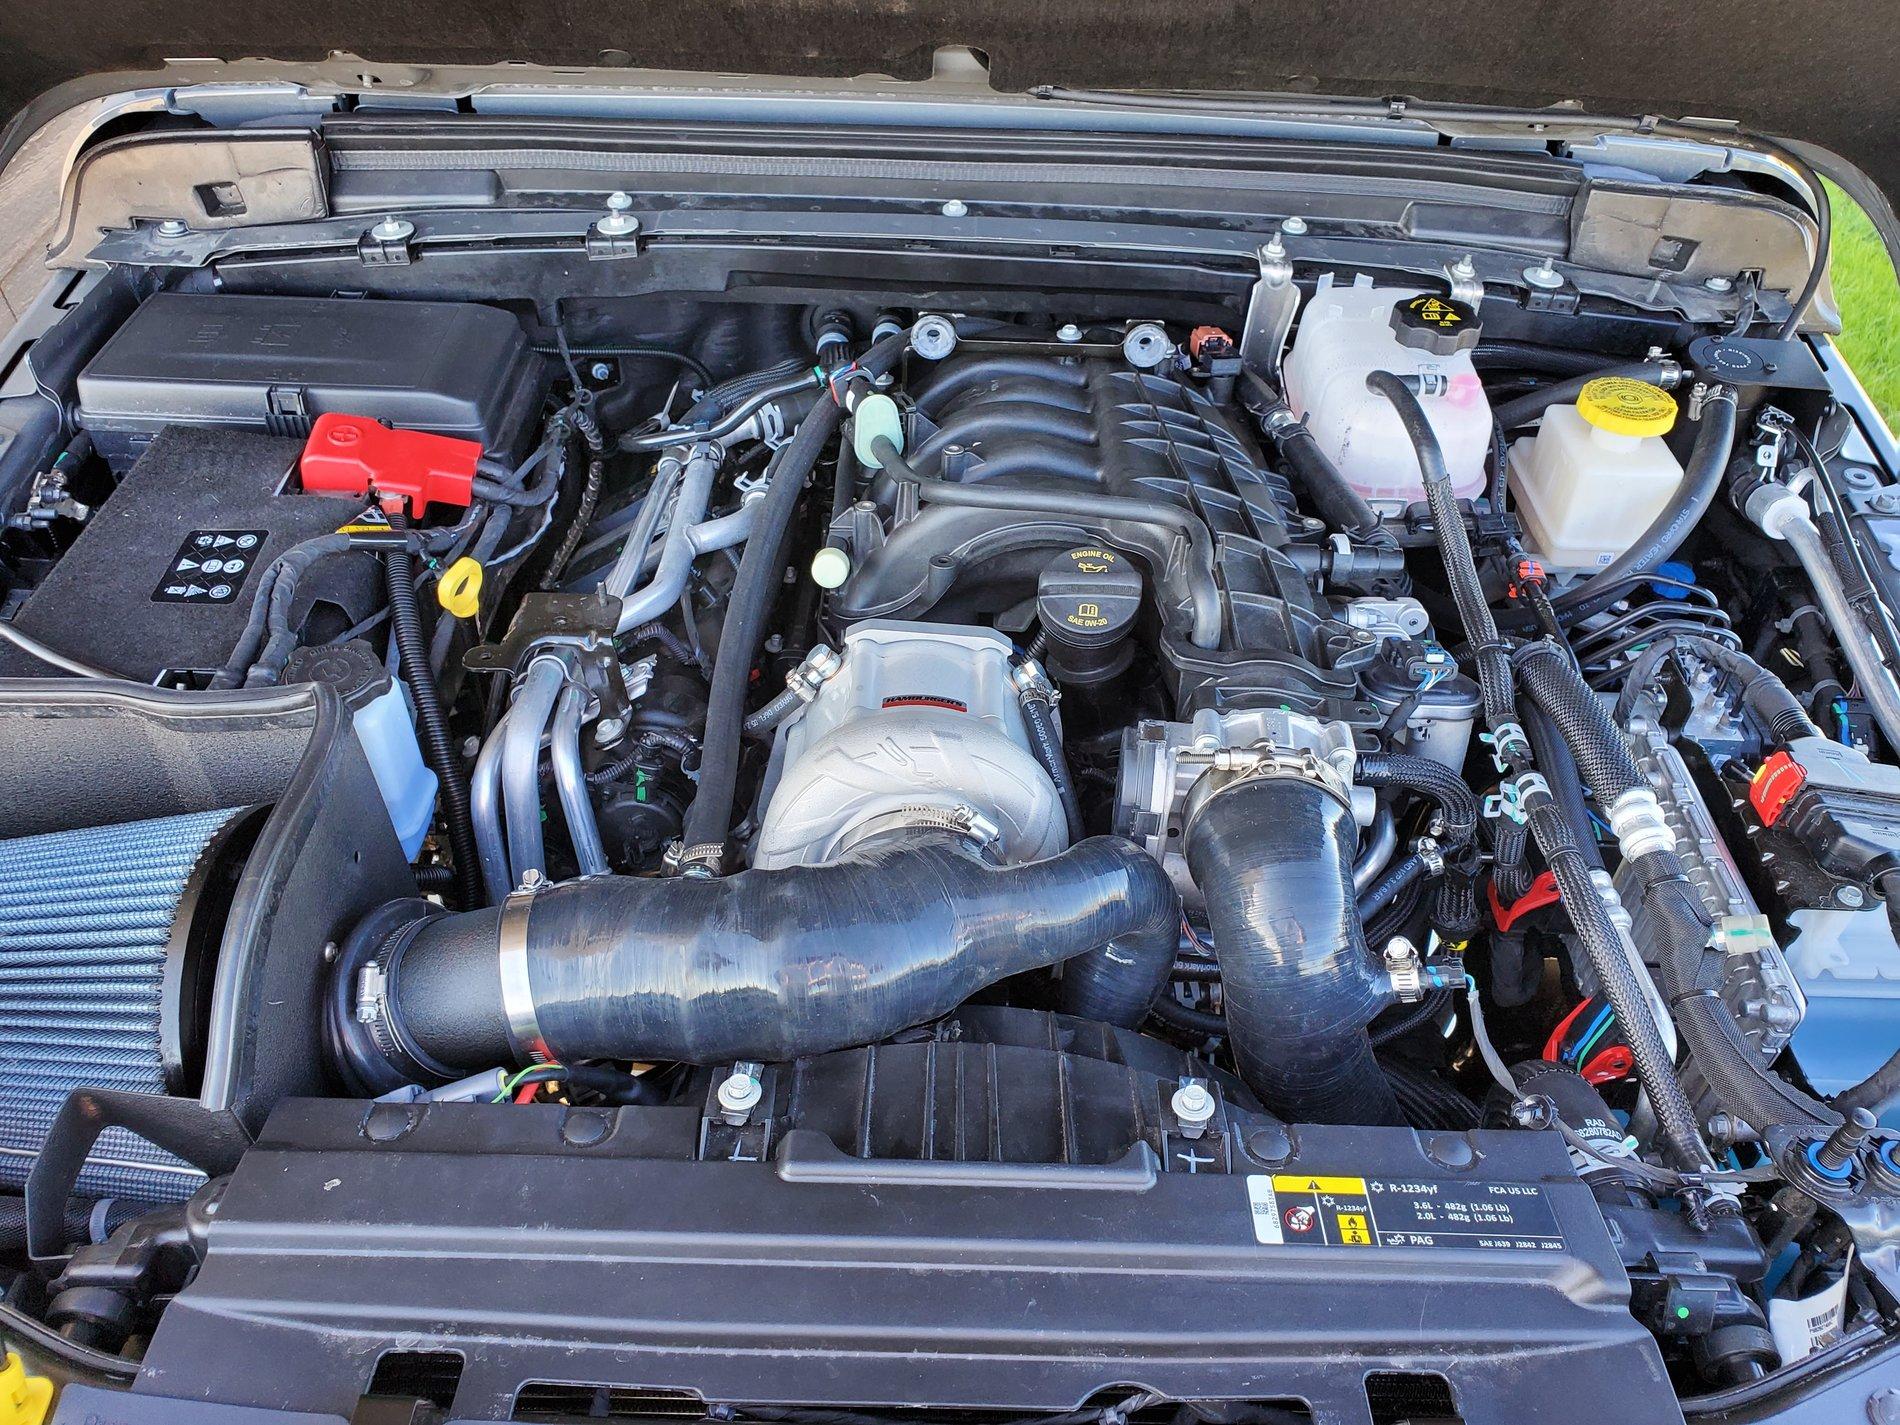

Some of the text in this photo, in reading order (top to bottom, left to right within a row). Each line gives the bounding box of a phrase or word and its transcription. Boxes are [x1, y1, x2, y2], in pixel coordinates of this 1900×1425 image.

[1635, 508, 1690, 571] STANDARD HEATER
[1071, 550, 1115, 563] ENGINE OIL
[1067, 615, 1108, 627] SAE 0W-20
[774, 692, 794, 711] DAYCO
[1372, 885, 1388, 901] BAR
[1584, 1118, 1606, 1127] RAD
[1389, 1183, 1539, 1195] R-1234yf FCA US LLC
[1336, 1204, 1367, 1213] R-1234yf
[1413, 1201, 1434, 1210] 3.6L
[1445, 1202, 1467, 1212] 482g
[1470, 1202, 1494, 1212] (1.06
[1495, 1203, 1510, 1214] Lb)
[1416, 1212, 1437, 1220] 2.0L
[1448, 1213, 1471, 1223] 482g
[1474, 1213, 1497, 1223] (1.06
[1499, 1214, 1514, 1224] Lb)
[1409, 1235, 1434, 1245] PAG
[1479, 1240, 1494, 1248] SAE
